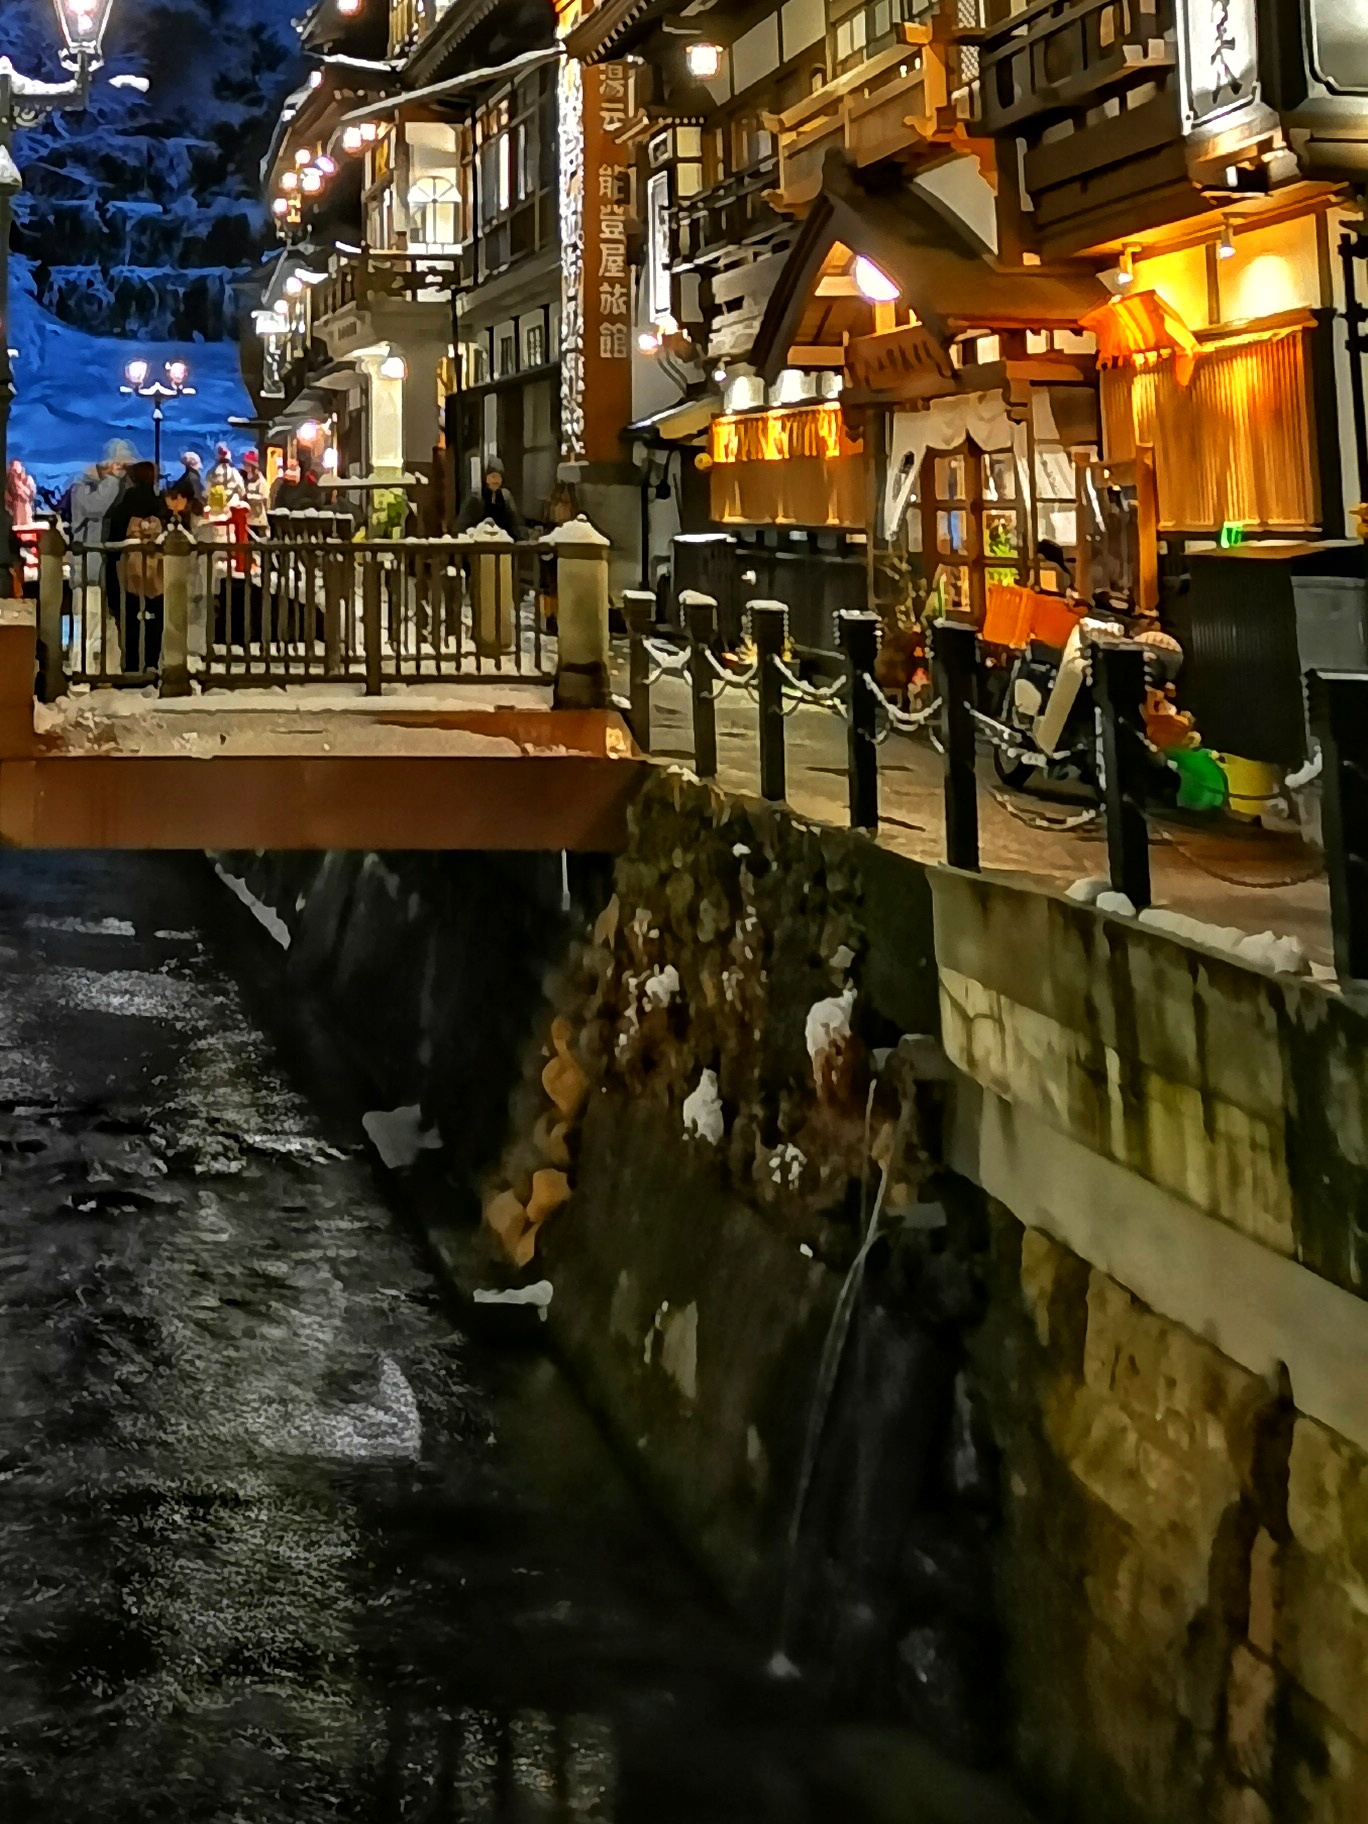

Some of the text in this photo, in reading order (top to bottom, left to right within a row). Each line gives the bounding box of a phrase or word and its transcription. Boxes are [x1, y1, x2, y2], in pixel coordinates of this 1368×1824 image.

[598, 163, 627, 359] 能登屋旅館
